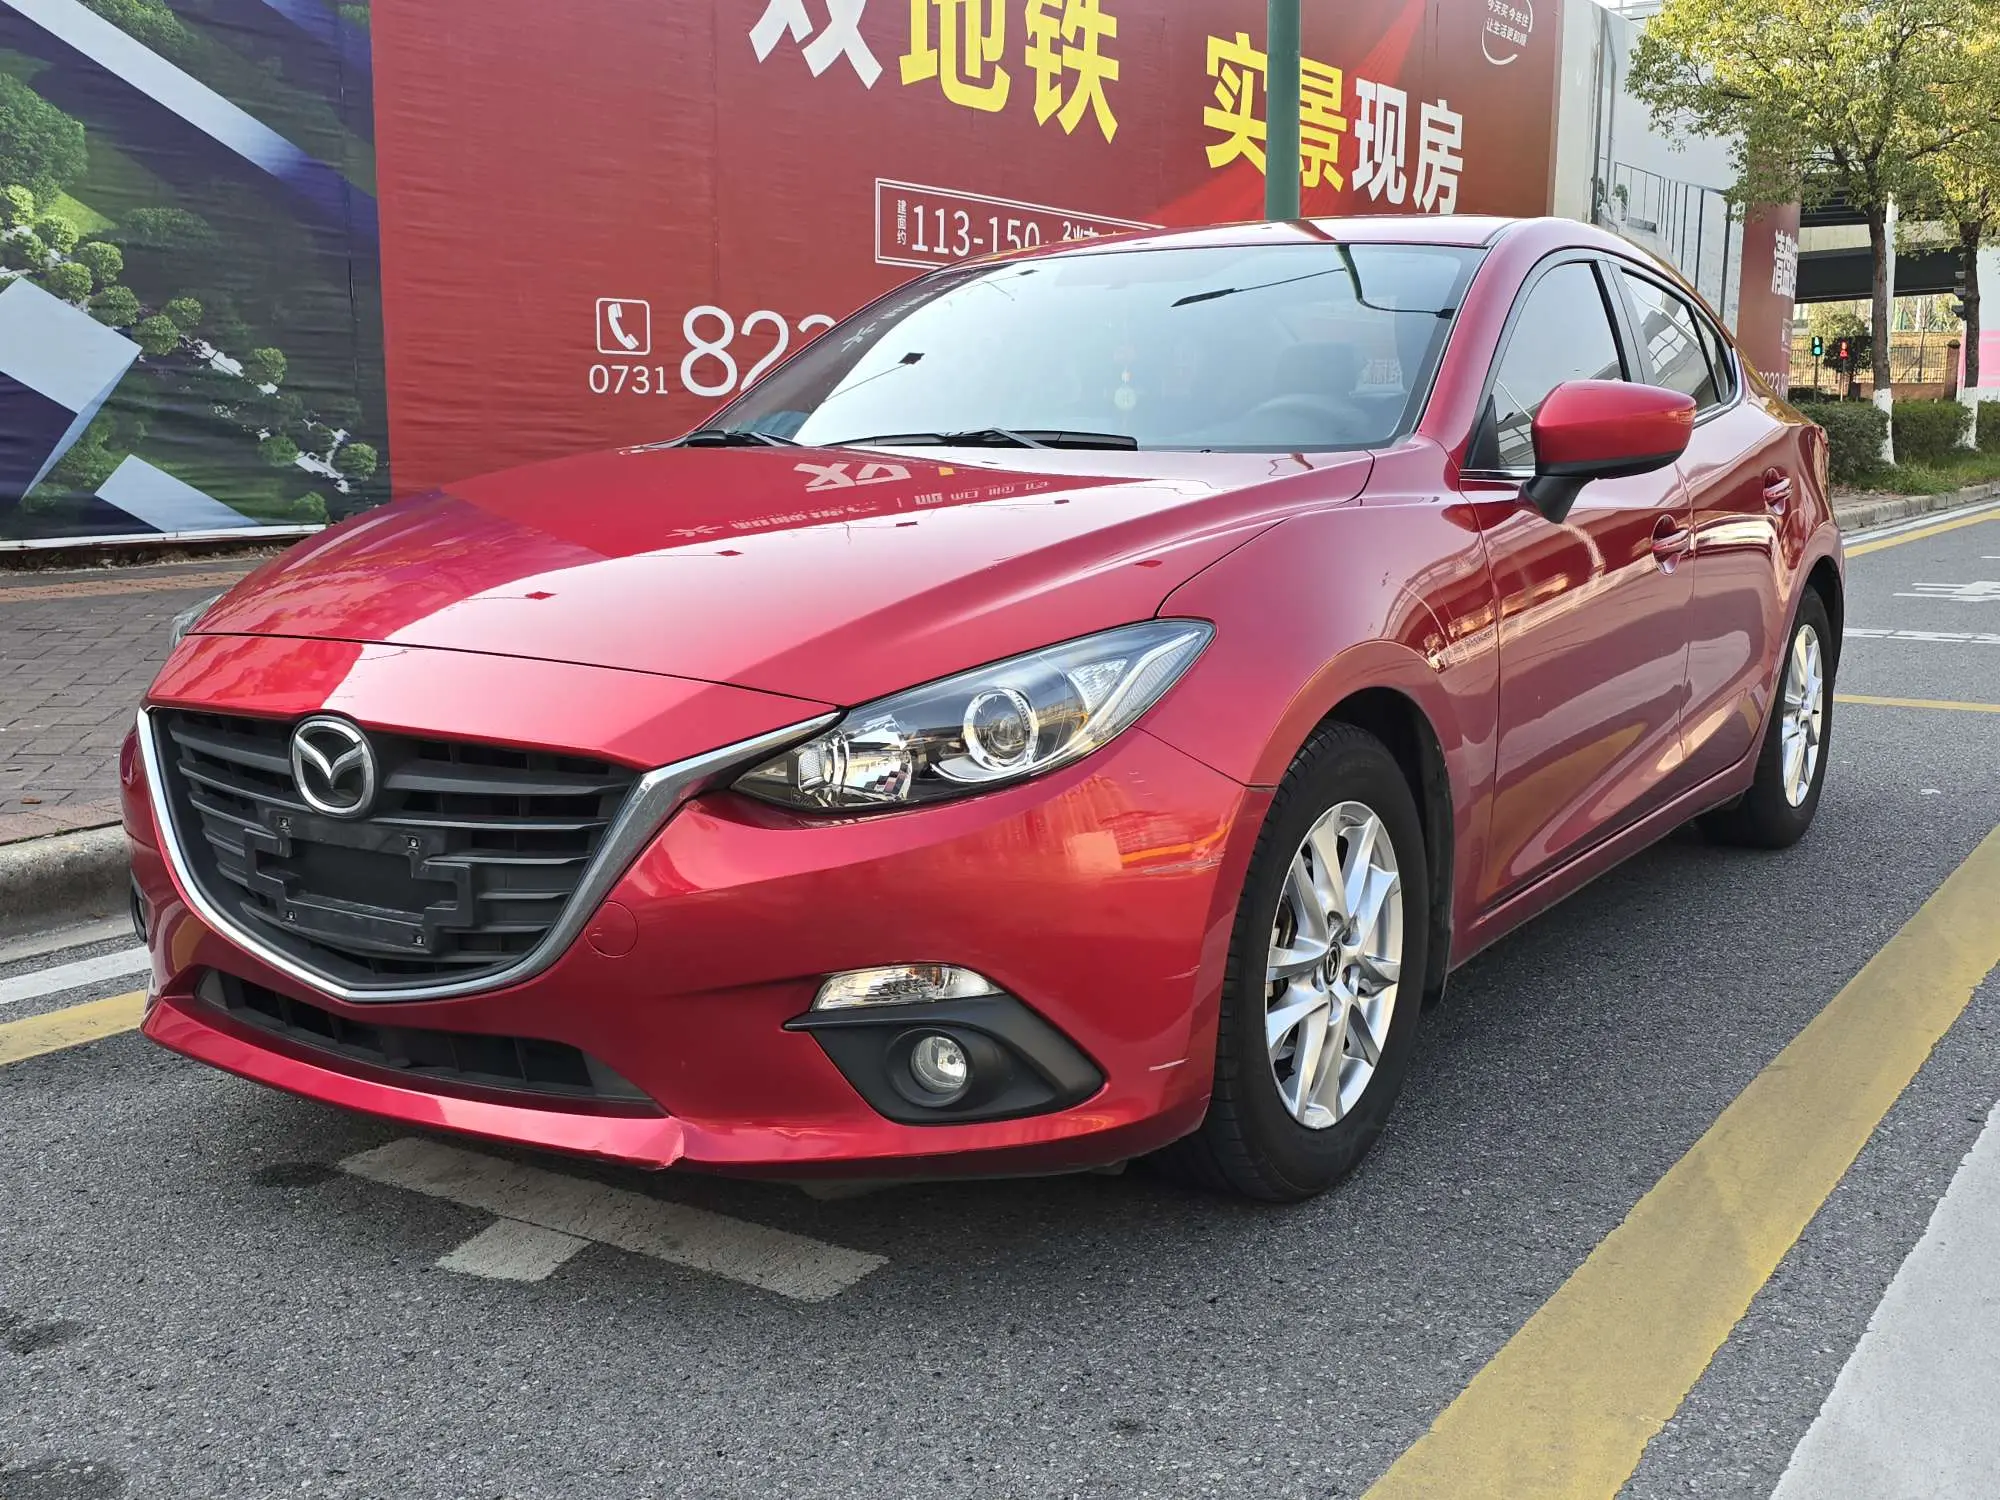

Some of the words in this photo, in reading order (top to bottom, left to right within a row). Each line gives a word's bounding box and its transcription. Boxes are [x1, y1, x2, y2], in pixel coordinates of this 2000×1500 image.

[1203, 32, 1463, 214] 实景现房
[589, 364, 668, 394] 0731
